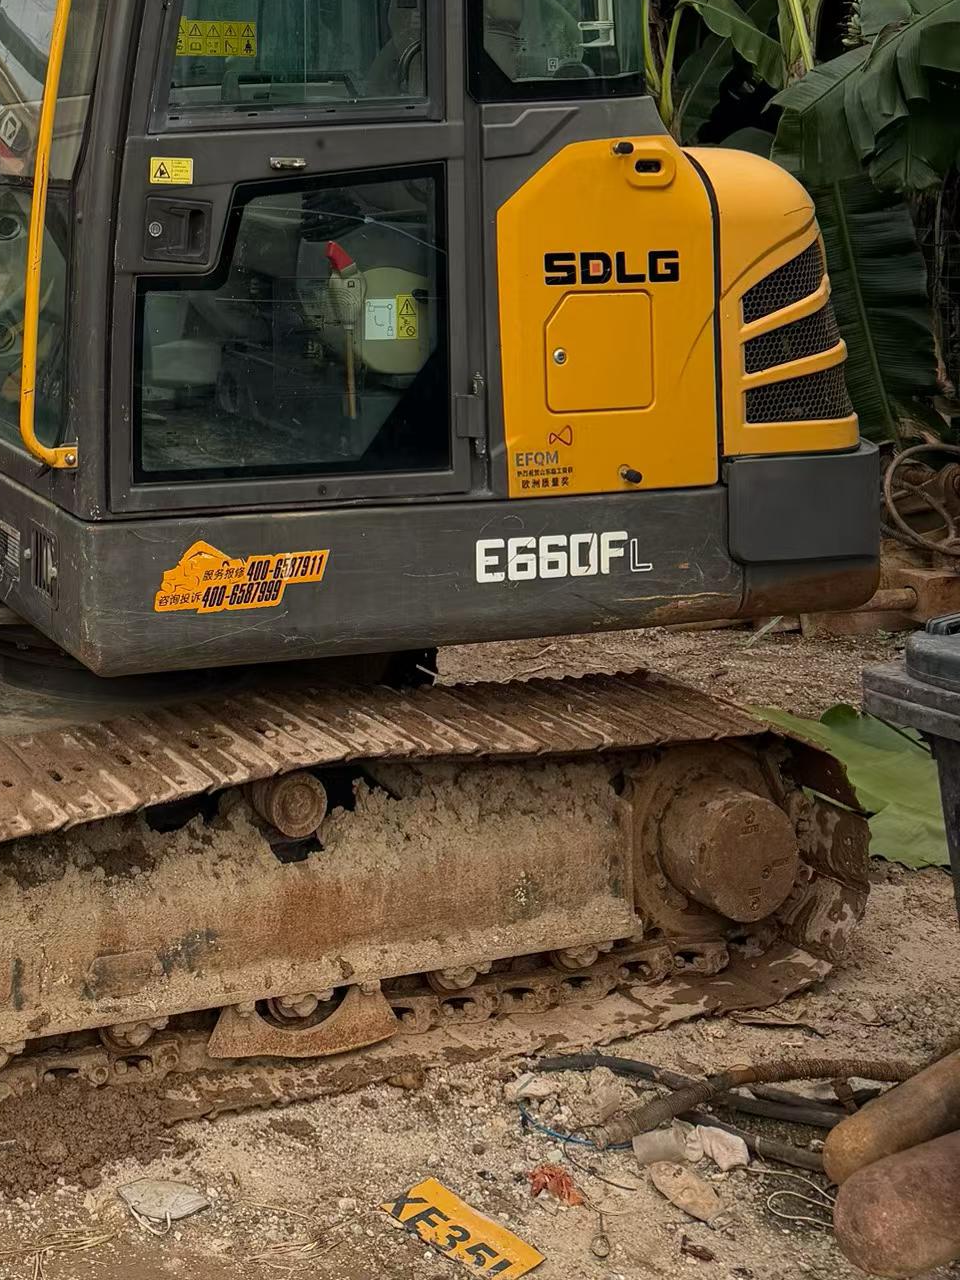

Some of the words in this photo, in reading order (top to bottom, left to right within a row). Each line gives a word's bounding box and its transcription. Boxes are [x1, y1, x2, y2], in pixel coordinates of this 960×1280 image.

[544, 250, 680, 285] SDLG
[515, 451, 559, 467] EFQM
[203, 567, 245, 581] 服务报修
[158, 591, 203, 607] 咨询投诉
[202, 580, 282, 608] 400-6587999
